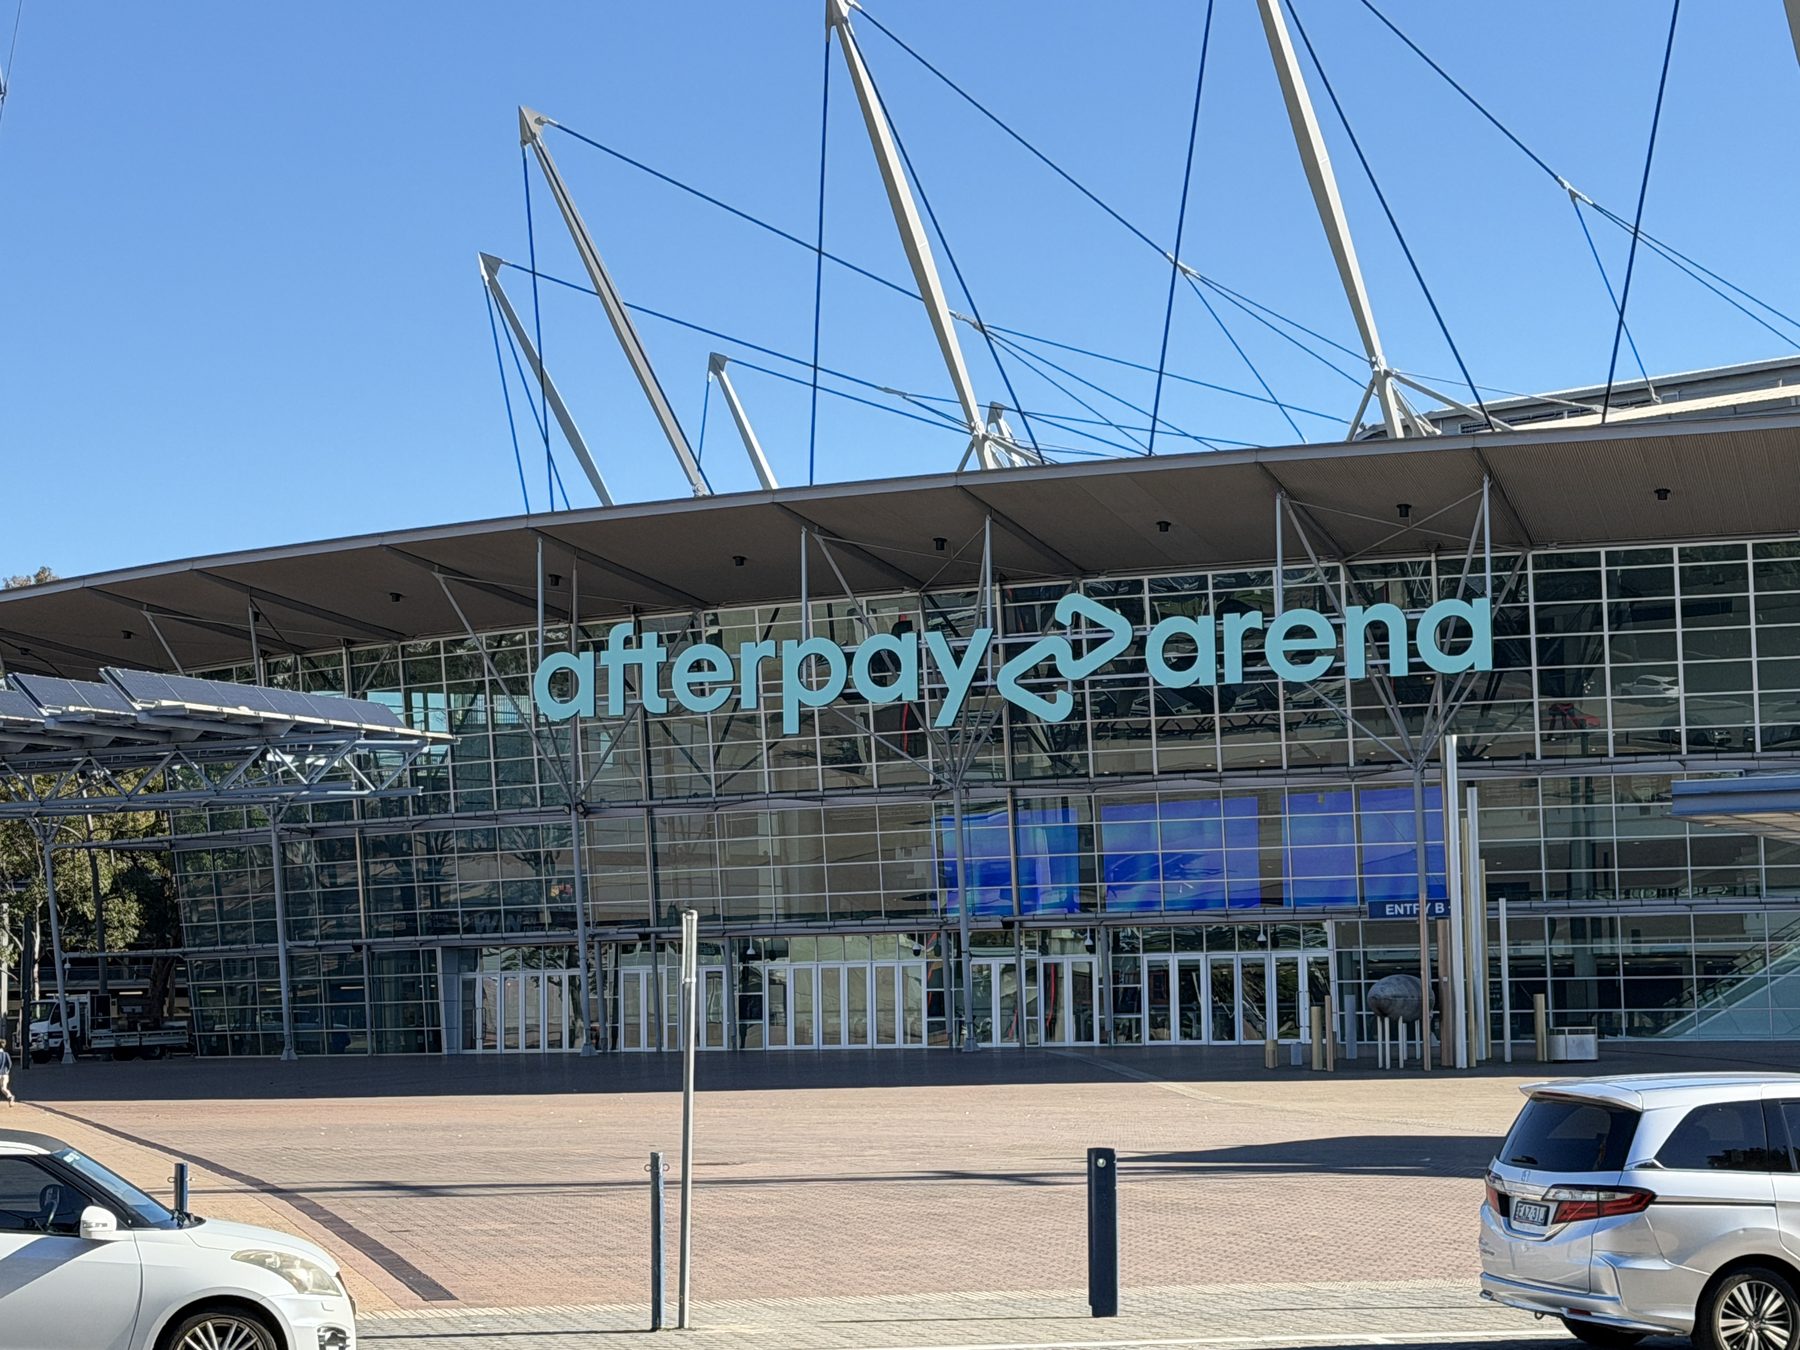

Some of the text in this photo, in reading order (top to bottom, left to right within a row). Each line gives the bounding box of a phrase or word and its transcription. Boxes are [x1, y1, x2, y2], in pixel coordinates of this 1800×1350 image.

[533, 591, 1494, 735] afterpay arena
[1434, 902, 1445, 914] B
